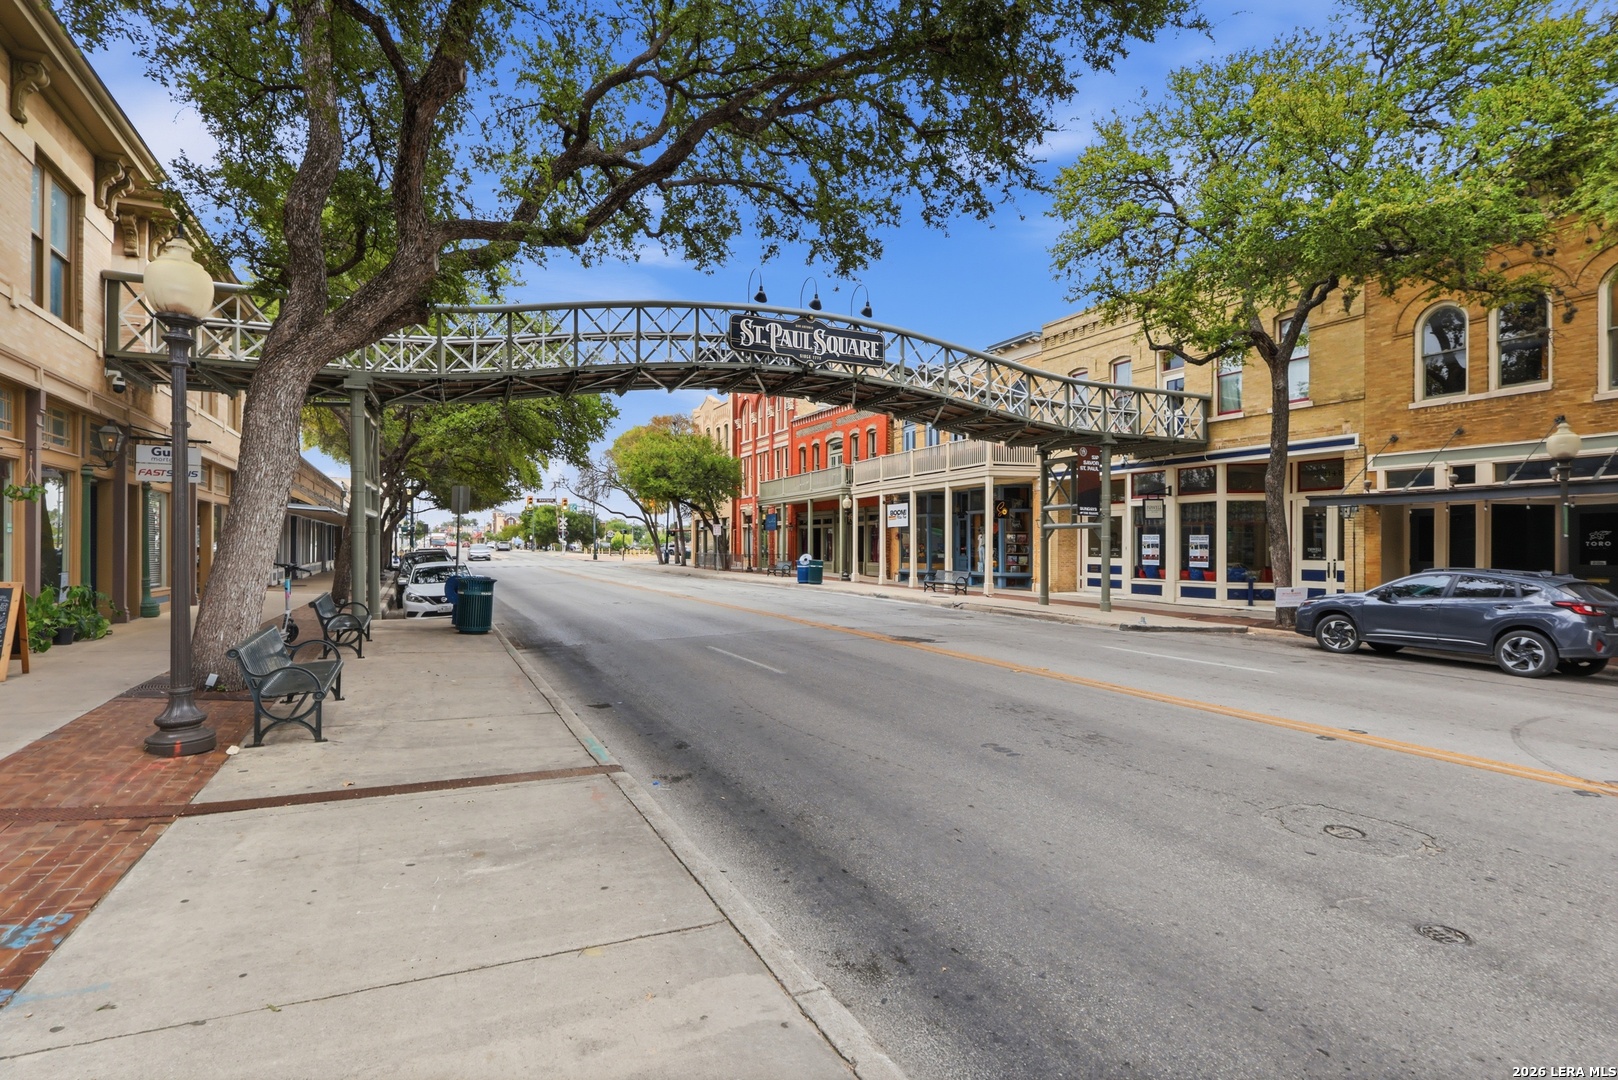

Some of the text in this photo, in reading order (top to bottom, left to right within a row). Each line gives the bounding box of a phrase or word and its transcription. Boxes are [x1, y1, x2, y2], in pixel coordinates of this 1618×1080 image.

[766, 322, 814, 354] PAUL
[813, 328, 880, 360] SQUARE
[138, 469, 198, 478] FASTSS
